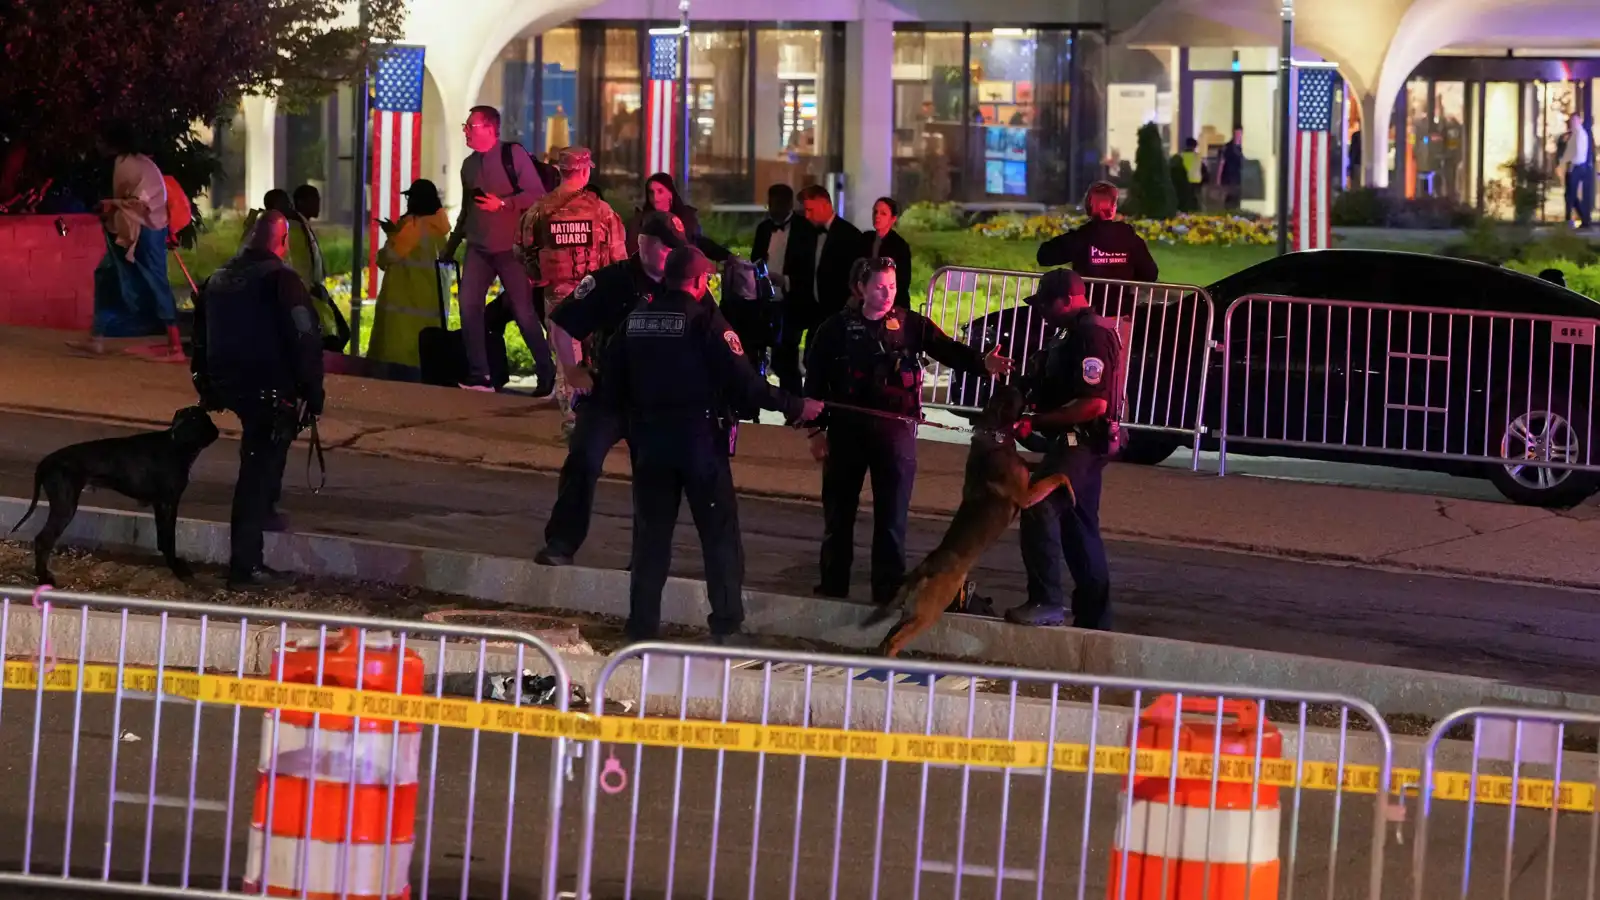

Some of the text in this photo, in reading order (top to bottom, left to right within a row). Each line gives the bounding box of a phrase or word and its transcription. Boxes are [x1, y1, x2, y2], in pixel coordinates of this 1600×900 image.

[550, 222, 591, 233] NATIONAL
[555, 233, 588, 245] GUARD
[229, 682, 257, 701] POLICE
[258, 685, 275, 703] LINE
[290, 689, 306, 706] NOT
[308, 690, 333, 709] CROSS
[363, 696, 389, 714] POLICE
[391, 698, 408, 716] LINE
[424, 702, 439, 719] NOT
[441, 703, 467, 722] CROSS
[631, 722, 659, 739] POLICE
[661, 725, 678, 741] LINE
[694, 727, 711, 744] NOT
[713, 728, 739, 746] CROSS
[769, 730, 797, 748] POLICE
[799, 732, 816, 750] LINE
[832, 735, 848, 753] NOT
[849, 736, 877, 754] CROSS
[907, 740, 936, 757] POLICE
[937, 742, 955, 759] LINE
[971, 744, 987, 761] NOT
[988, 745, 1015, 763] CROSS
